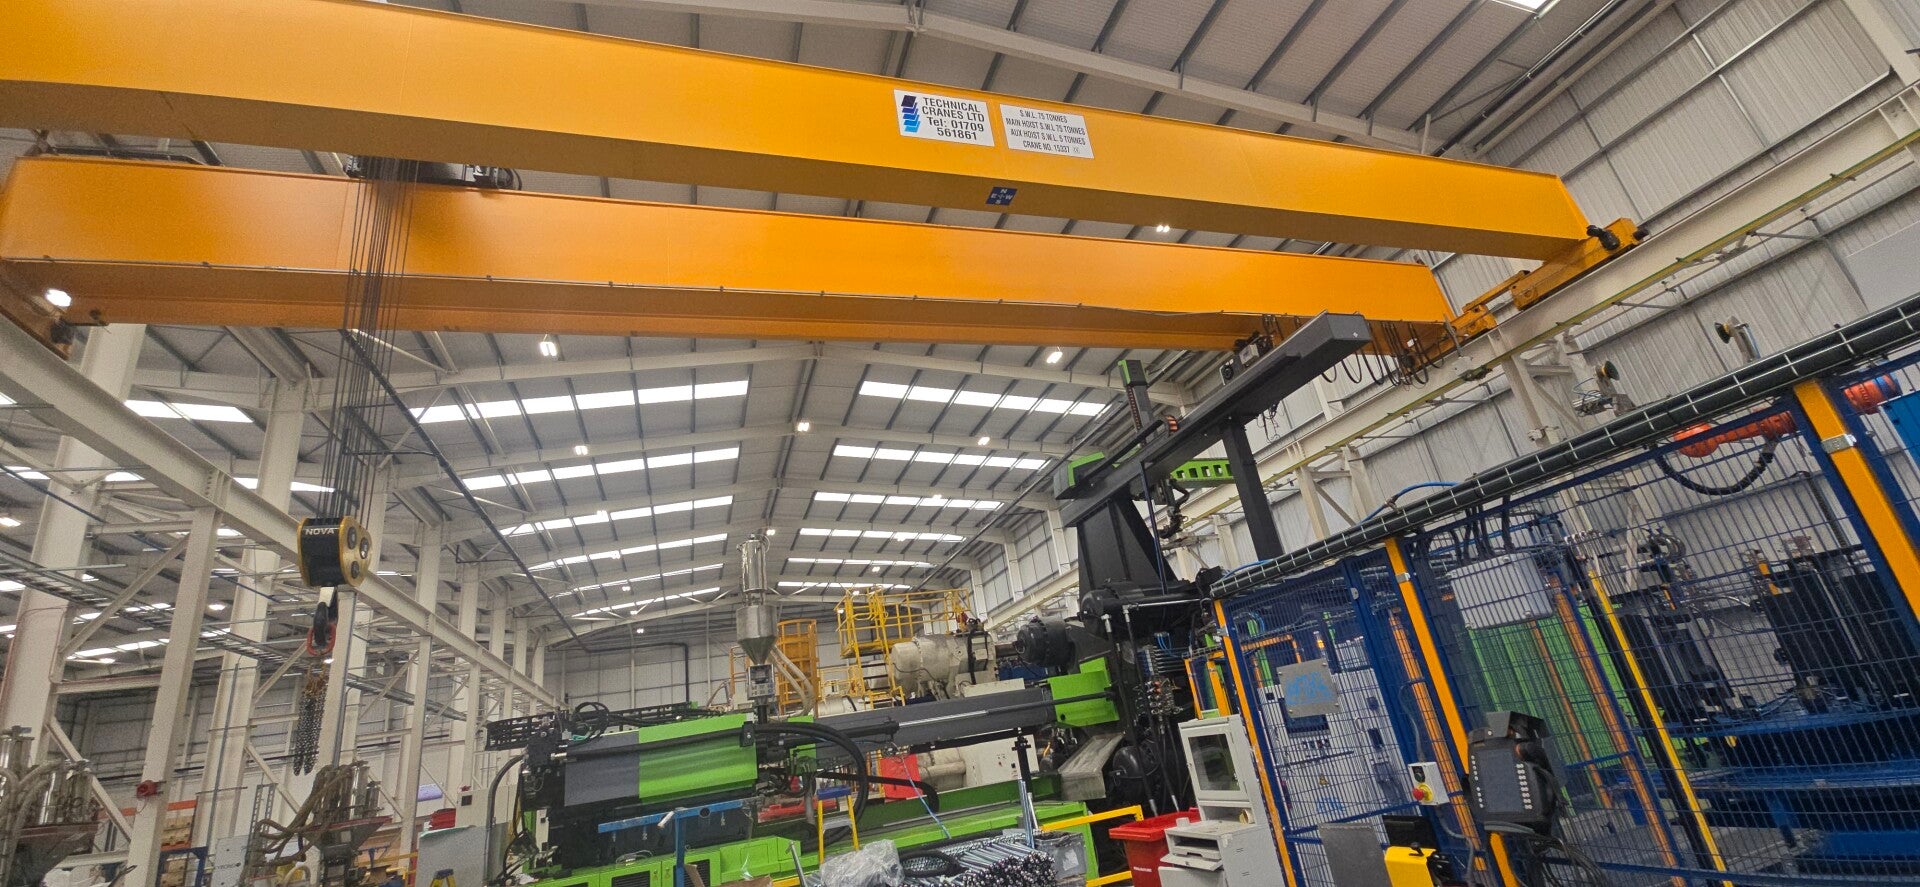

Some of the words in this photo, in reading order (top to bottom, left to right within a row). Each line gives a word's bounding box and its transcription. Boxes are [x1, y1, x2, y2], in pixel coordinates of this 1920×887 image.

[923, 97, 981, 113] TECHNICAL
[922, 106, 964, 120] CRANES
[967, 112, 985, 122] LTD
[1038, 112, 1046, 121] 75
[1046, 113, 1068, 124] TONNES
[926, 116, 947, 128] Tel:
[951, 120, 984, 132] 01709
[1005, 117, 1021, 127] MAIN
[1022, 120, 1039, 130] HOIST
[1055, 124, 1064, 133] 75
[1063, 125, 1086, 136] TONNES
[936, 127, 977, 140] 561861
[1010, 128, 1023, 138] AUX
[1023, 130, 1040, 140] HOIST
[1063, 135, 1086, 146] TONNES
[1022, 140, 1042, 150] CRANE
